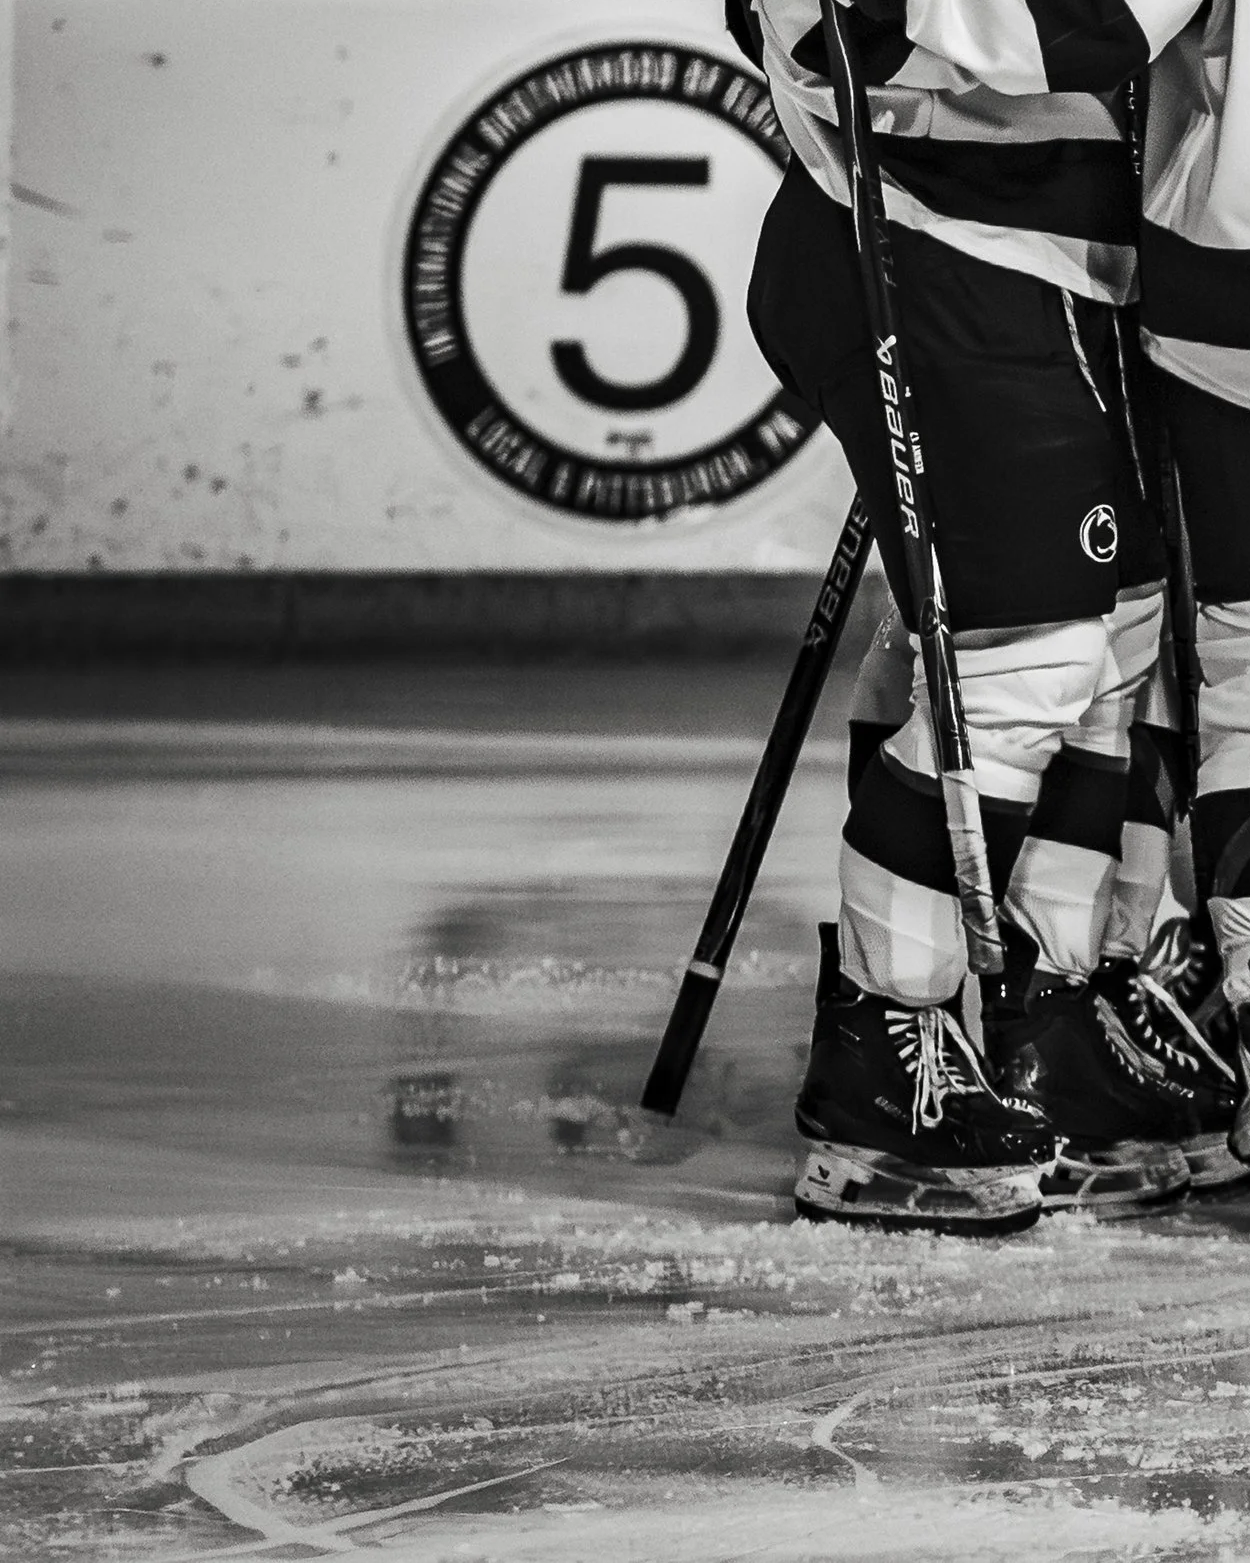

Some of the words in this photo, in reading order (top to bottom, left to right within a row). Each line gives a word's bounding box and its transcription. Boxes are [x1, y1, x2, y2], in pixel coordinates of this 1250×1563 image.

[550, 153, 721, 411] 5
[879, 369, 920, 539] BAUER
[819, 496, 869, 625] BAUE
